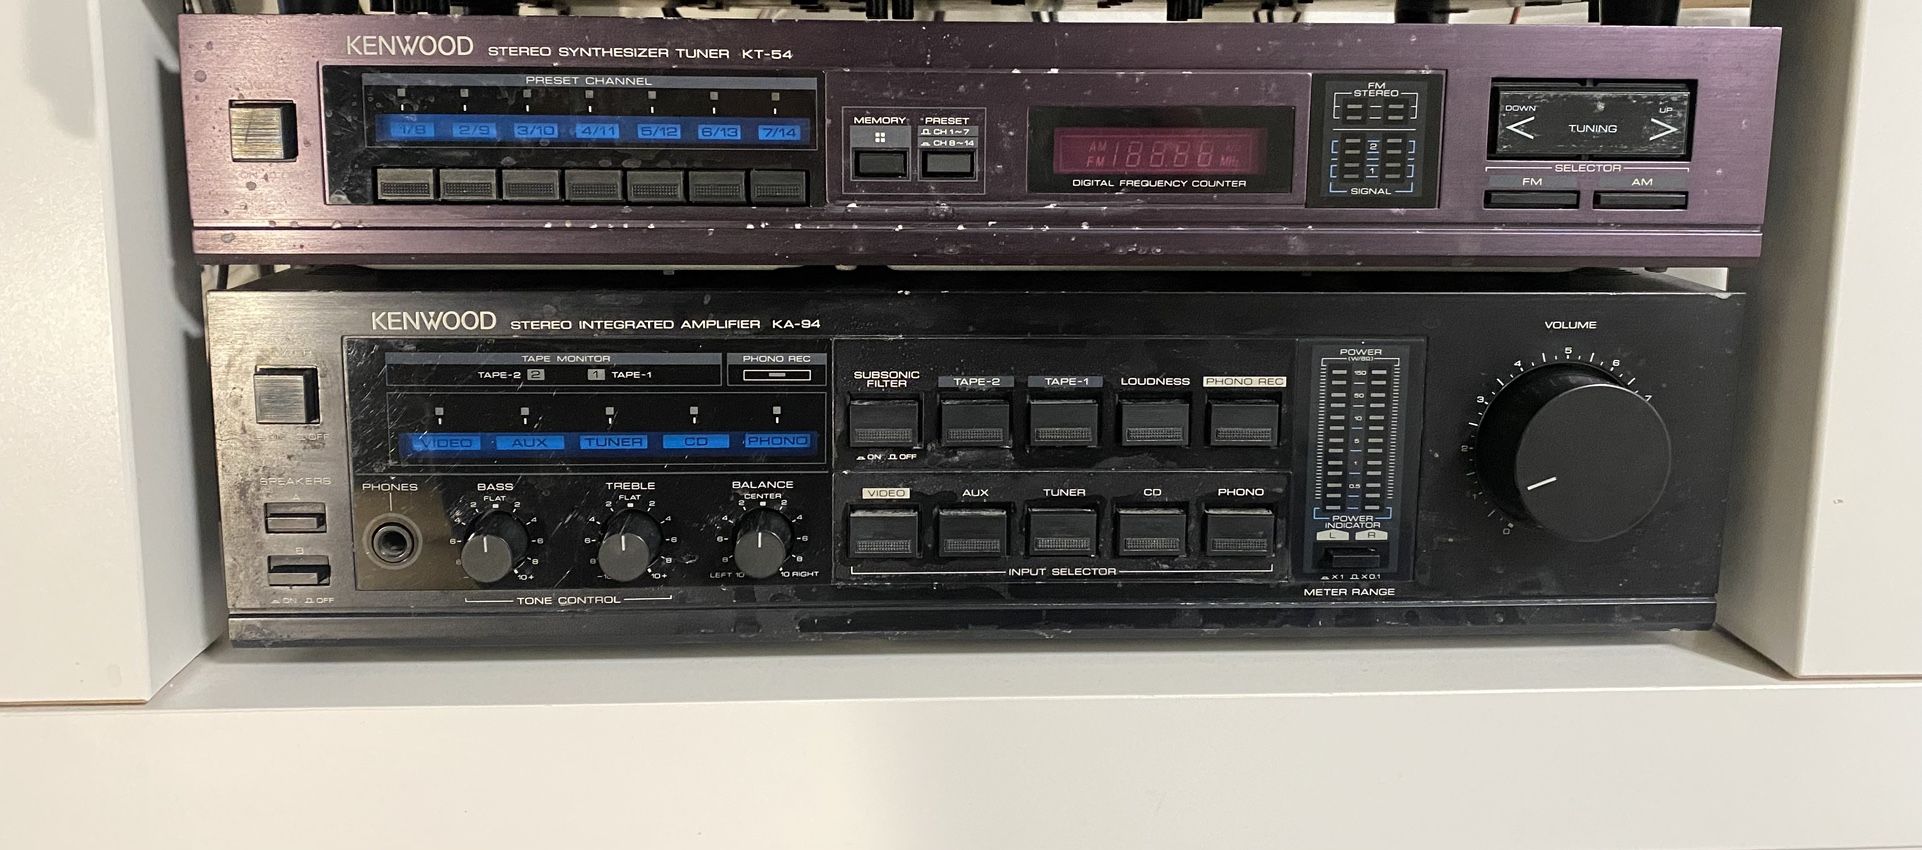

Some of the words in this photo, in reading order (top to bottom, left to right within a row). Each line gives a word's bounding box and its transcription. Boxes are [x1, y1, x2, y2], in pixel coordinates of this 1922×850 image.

[346, 35, 474, 56] KENWOOD
[488, 46, 551, 57] STEREO
[558, 47, 669, 58] SYNTHESIZER
[675, 48, 729, 59] TUNER
[742, 49, 793, 60] KT-54
[525, 76, 579, 86] PRESET
[585, 76, 652, 86] CHANNEL
[1354, 89, 1399, 98] STEREO
[853, 116, 907, 125] MEMORY
[924, 117, 970, 126] PRESET
[398, 124, 427, 136] 1/8
[458, 124, 490, 137] 2/9
[516, 124, 554, 138] 3/10
[580, 124, 616, 138] 4/11
[640, 124, 678, 138] 5/12
[700, 124, 739, 138] 6/13
[760, 125, 798, 138] 7/14
[1568, 125, 1618, 134] TUNING
[1089, 141, 1107, 152] AM
[1370, 142, 1378, 151] 2
[1086, 156, 1106, 168] FM
[1370, 167, 1375, 175] 1
[1555, 164, 1622, 173] SELECTOR
[1072, 179, 1115, 187] DIGITAL
[1119, 179, 1189, 188] FREQUENCY
[1191, 180, 1247, 188] COUNTER
[1522, 178, 1542, 186] FM
[1632, 178, 1653, 186] AM
[1350, 187, 1392, 196] SIGNAL
[372, 311, 497, 331] KENWOOD
[510, 320, 572, 331] STEREO
[578, 320, 674, 330] INTEGRATED
[681, 320, 761, 329] AMPLIFIER
[772, 319, 821, 329] KA-94
[1544, 321, 1598, 330] VOLUME
[521, 354, 551, 363] TAPE
[556, 354, 611, 363] MONITOR
[742, 354, 781, 363] PHONO
[788, 354, 811, 363] REC
[478, 370, 522, 380] TAPE-2
[530, 370, 542, 380] 2
[592, 370, 600, 379] 1
[612, 370, 652, 380] TAPE-1
[854, 370, 920, 380] SUBSONIC
[866, 379, 907, 388] FILTER
[953, 378, 1000, 386] TAPE-2
[1044, 378, 1090, 386] TAPE-1
[1120, 377, 1190, 386] LOUDNESS
[1206, 377, 1253, 386] PHONO
[1258, 377, 1284, 386] REC
[422, 437, 472, 448] VIDEO
[512, 437, 548, 448] AUX
[584, 436, 644, 447] TUNER
[682, 436, 708, 446] CD
[748, 436, 808, 446] PHONO
[260, 478, 332, 486] SPEAKERS
[732, 480, 794, 488] BALANCE
[477, 483, 514, 491] BASS
[867, 489, 906, 498] VIDEO
[962, 488, 990, 497] AUX
[1043, 488, 1086, 497] TUNER
[1143, 488, 1162, 496] CD
[1218, 488, 1264, 496] PHONO
[1008, 568, 1047, 576] INPUT
[1052, 568, 1116, 576] SELECTOR
[1304, 588, 1348, 596] METER
[1352, 588, 1396, 596] RANGE
[516, 596, 552, 606] TONE
[558, 596, 621, 605] CONTROL
